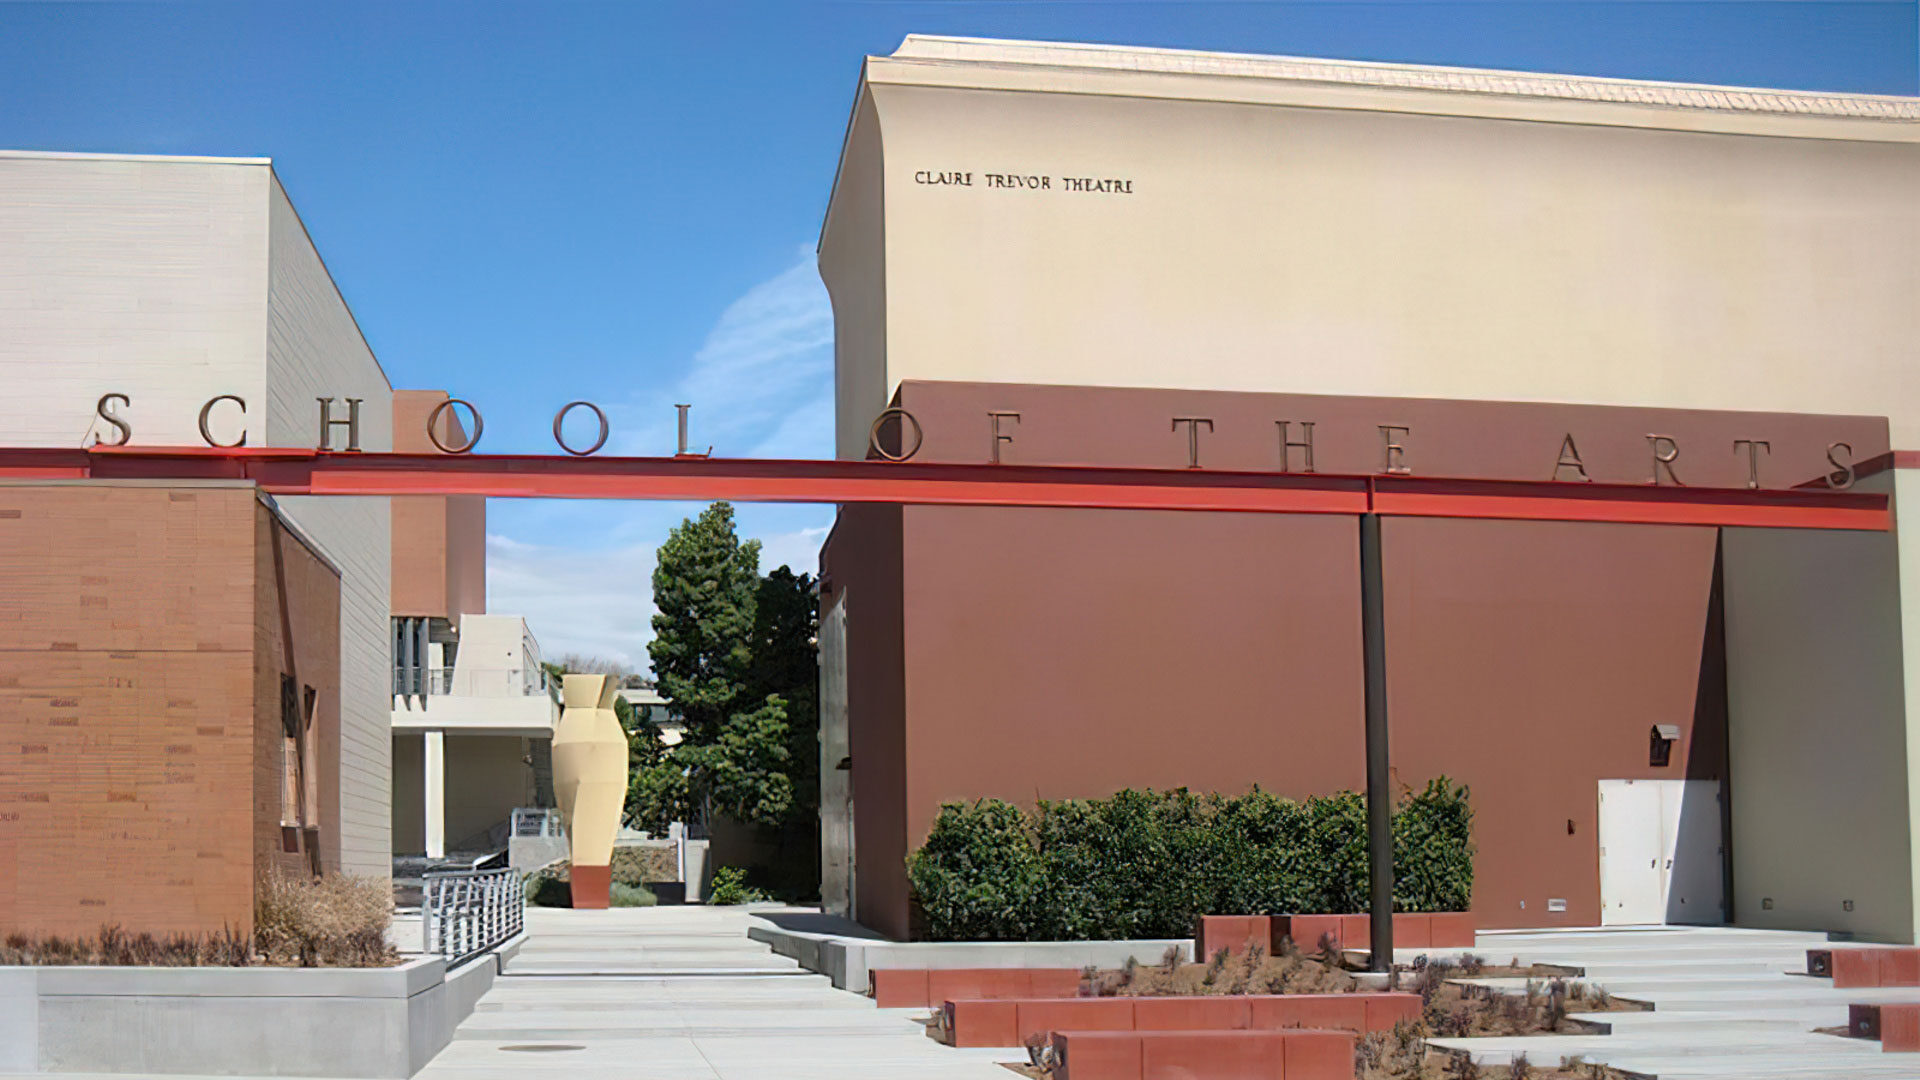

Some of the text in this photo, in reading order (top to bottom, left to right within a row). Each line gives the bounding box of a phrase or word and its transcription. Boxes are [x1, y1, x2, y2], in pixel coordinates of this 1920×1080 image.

[914, 171, 1133, 193] CLAIRE TREVOR THEATRE
[95, 392, 1855, 490] SCHOOL OF THE ARTS
